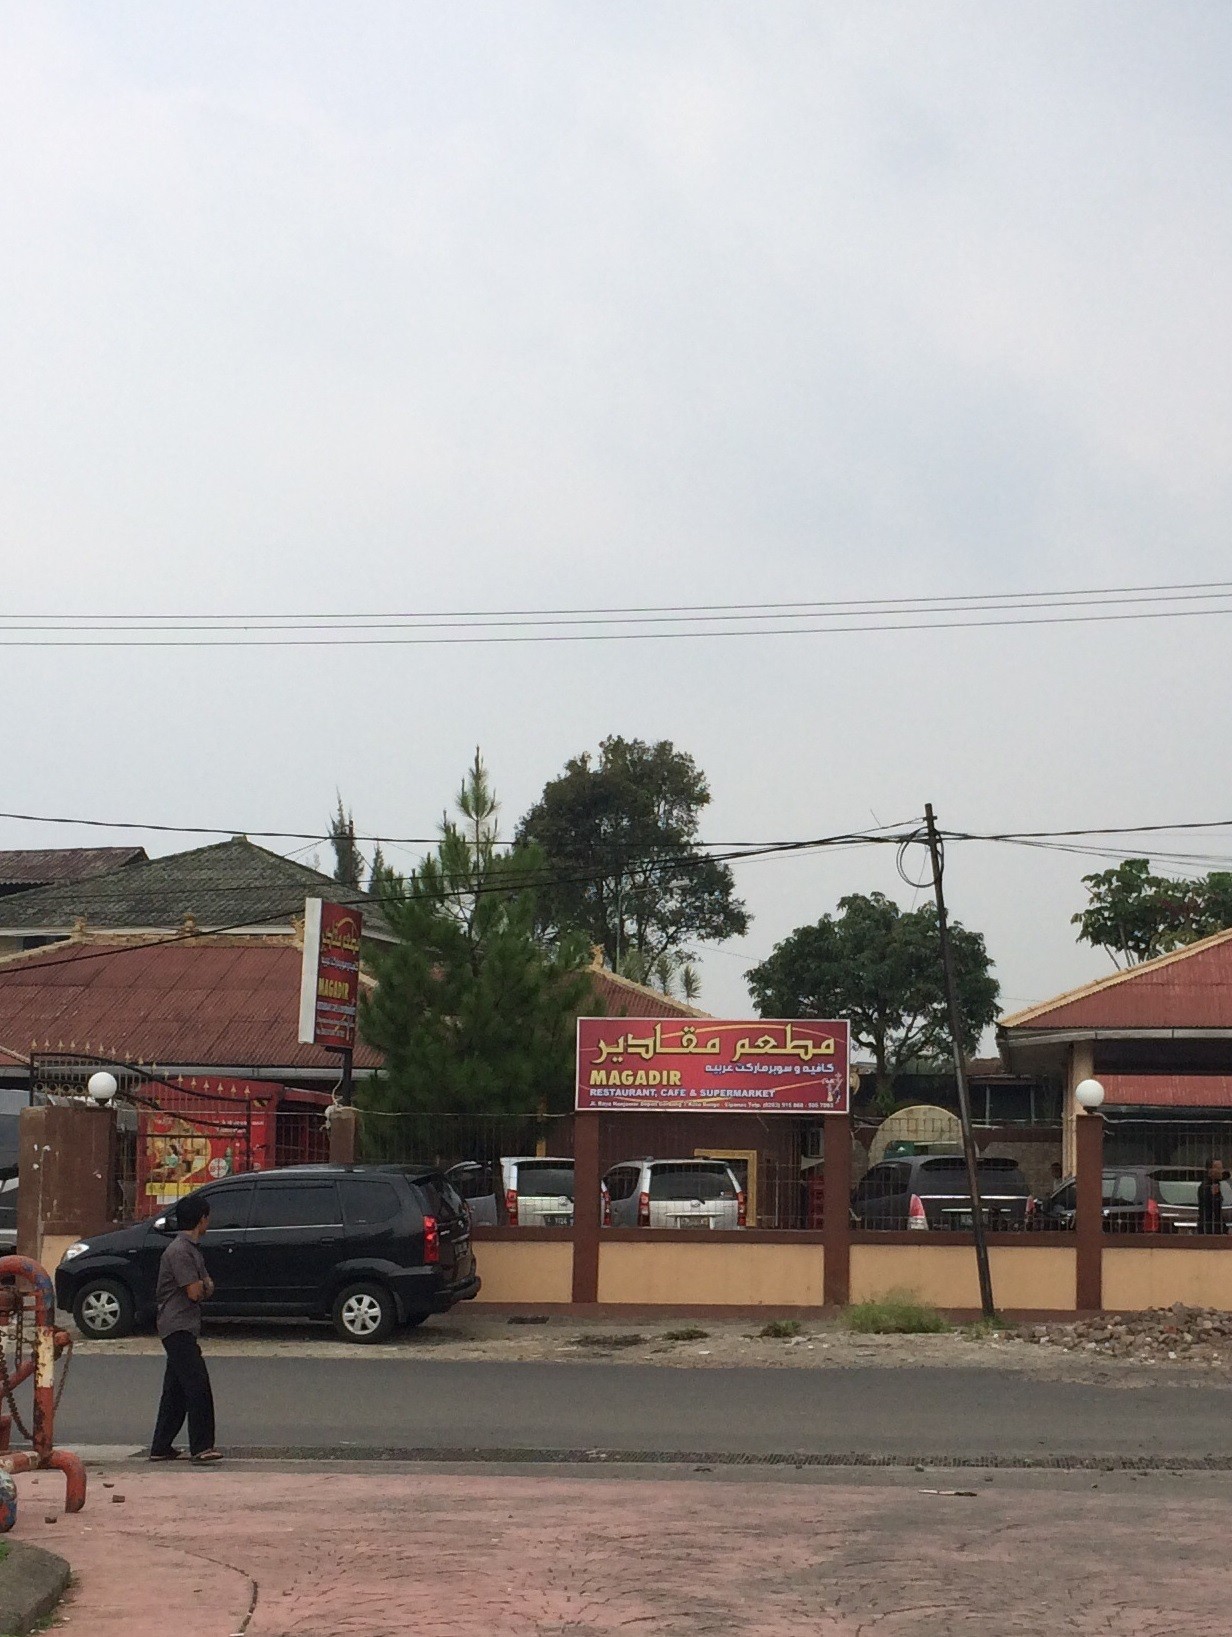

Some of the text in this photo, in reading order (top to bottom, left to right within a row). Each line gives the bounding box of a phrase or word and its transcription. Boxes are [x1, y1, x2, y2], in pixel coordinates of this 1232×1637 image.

[318, 977, 350, 1000] MAGADIR
[591, 1022, 835, 1064] مطعم مقادير
[590, 1070, 681, 1086] MAGADIR
[794, 1066, 801, 1074] و
[590, 1088, 775, 1098] RESTAURANT, CAFE & SUPERMARKET
